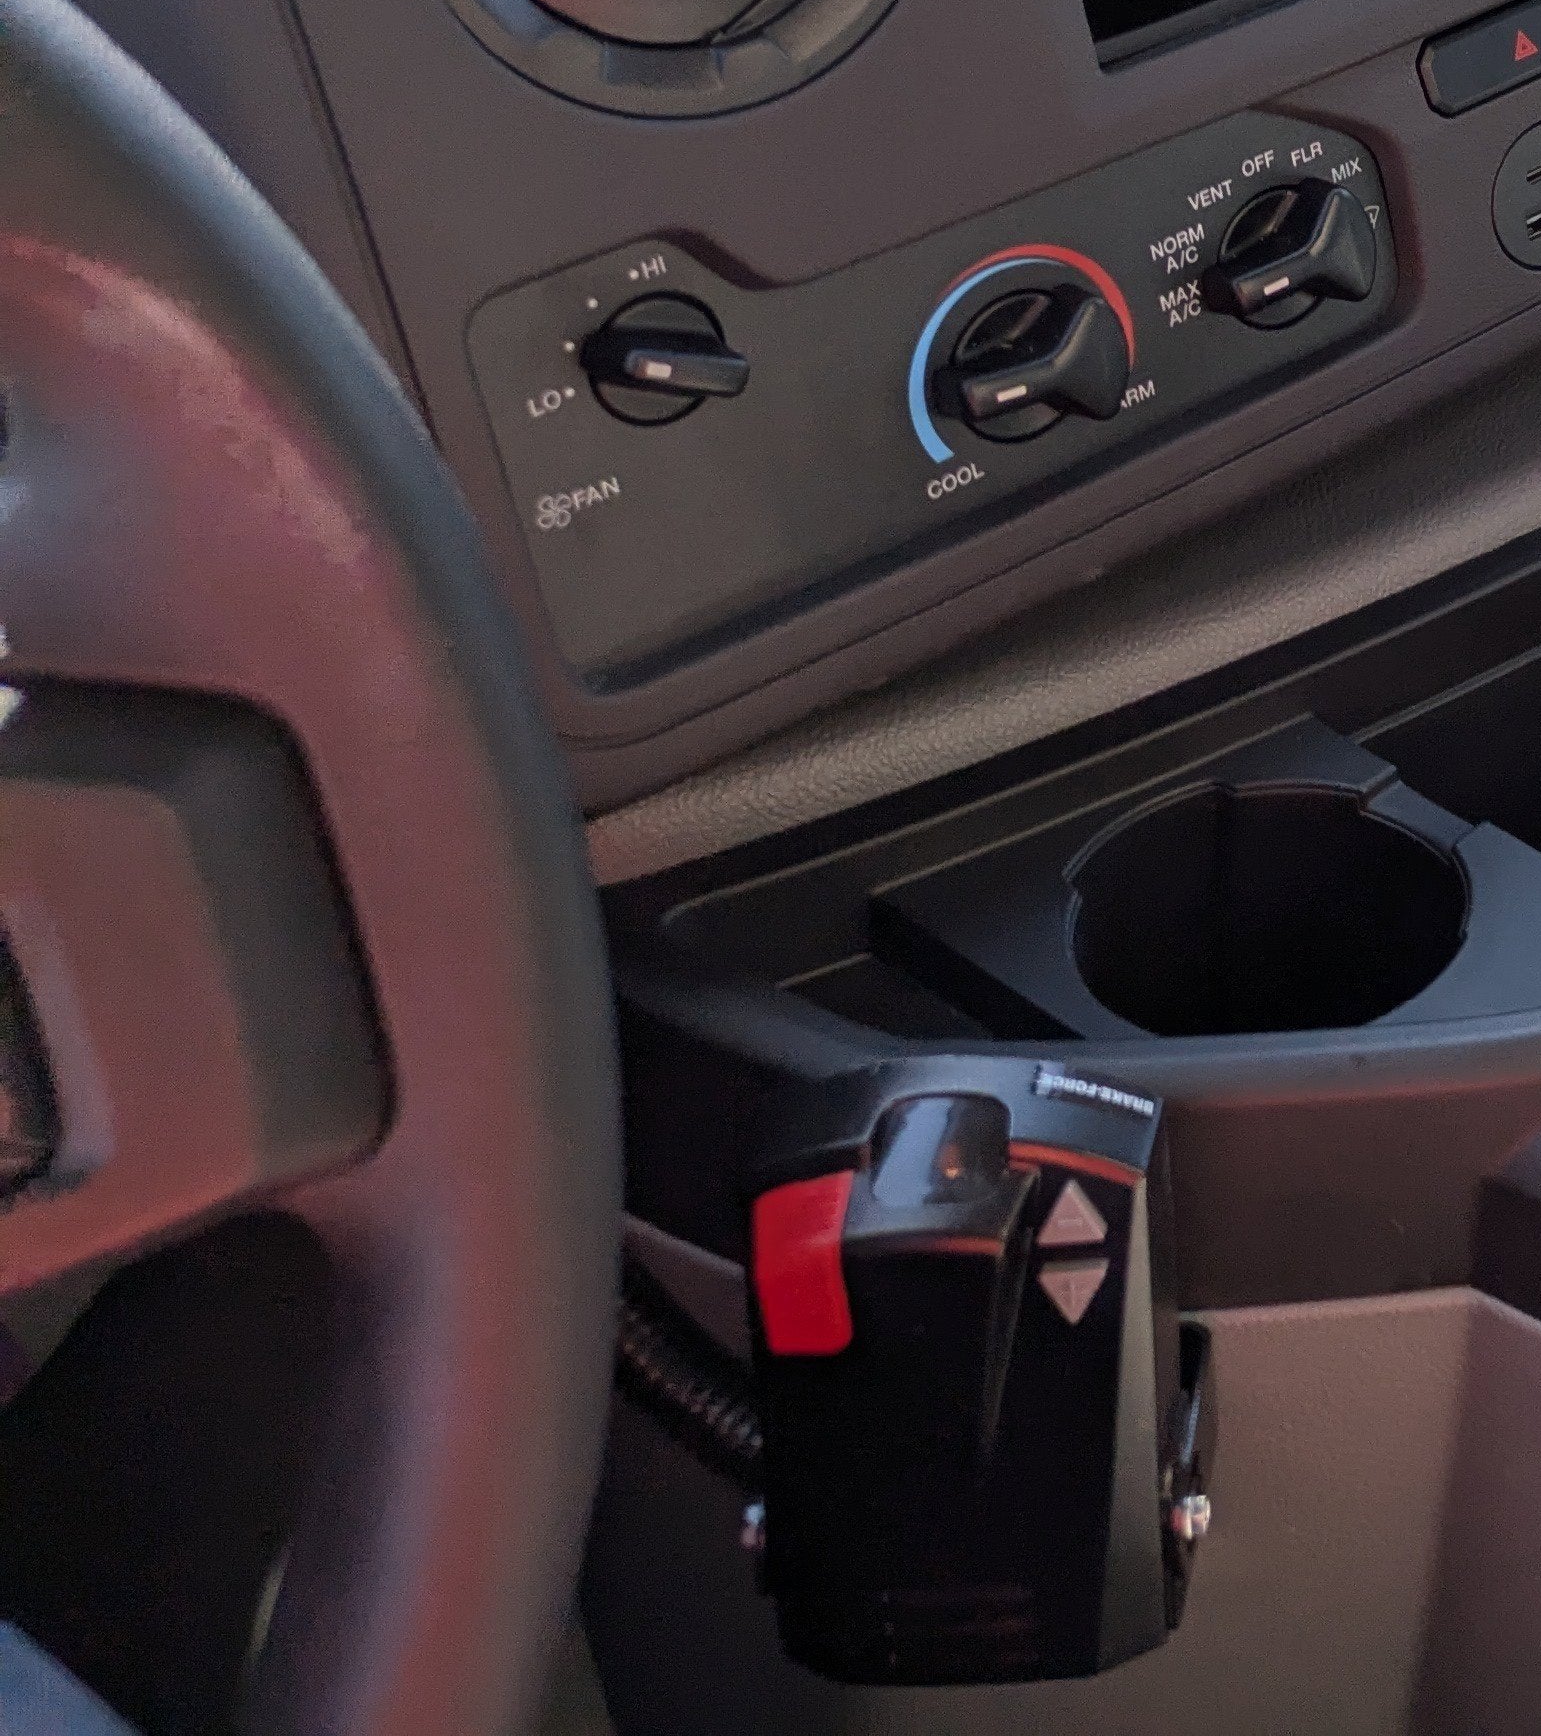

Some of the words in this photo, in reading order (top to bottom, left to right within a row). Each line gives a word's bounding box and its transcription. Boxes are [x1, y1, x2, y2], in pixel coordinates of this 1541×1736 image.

[1241, 150, 1275, 178] OFF
[1291, 141, 1323, 167] FLR
[1331, 157, 1362, 184] MIX
[1187, 179, 1233, 211] VENT
[1149, 223, 1205, 261] NORM
[640, 253, 667, 280] HI
[1166, 246, 1199, 275] A/C
[1159, 279, 1201, 312] MAX
[1169, 298, 1201, 328] A/C
[526, 389, 562, 418] LO
[571, 476, 621, 511] FAN
[926, 462, 985, 500] COOL
